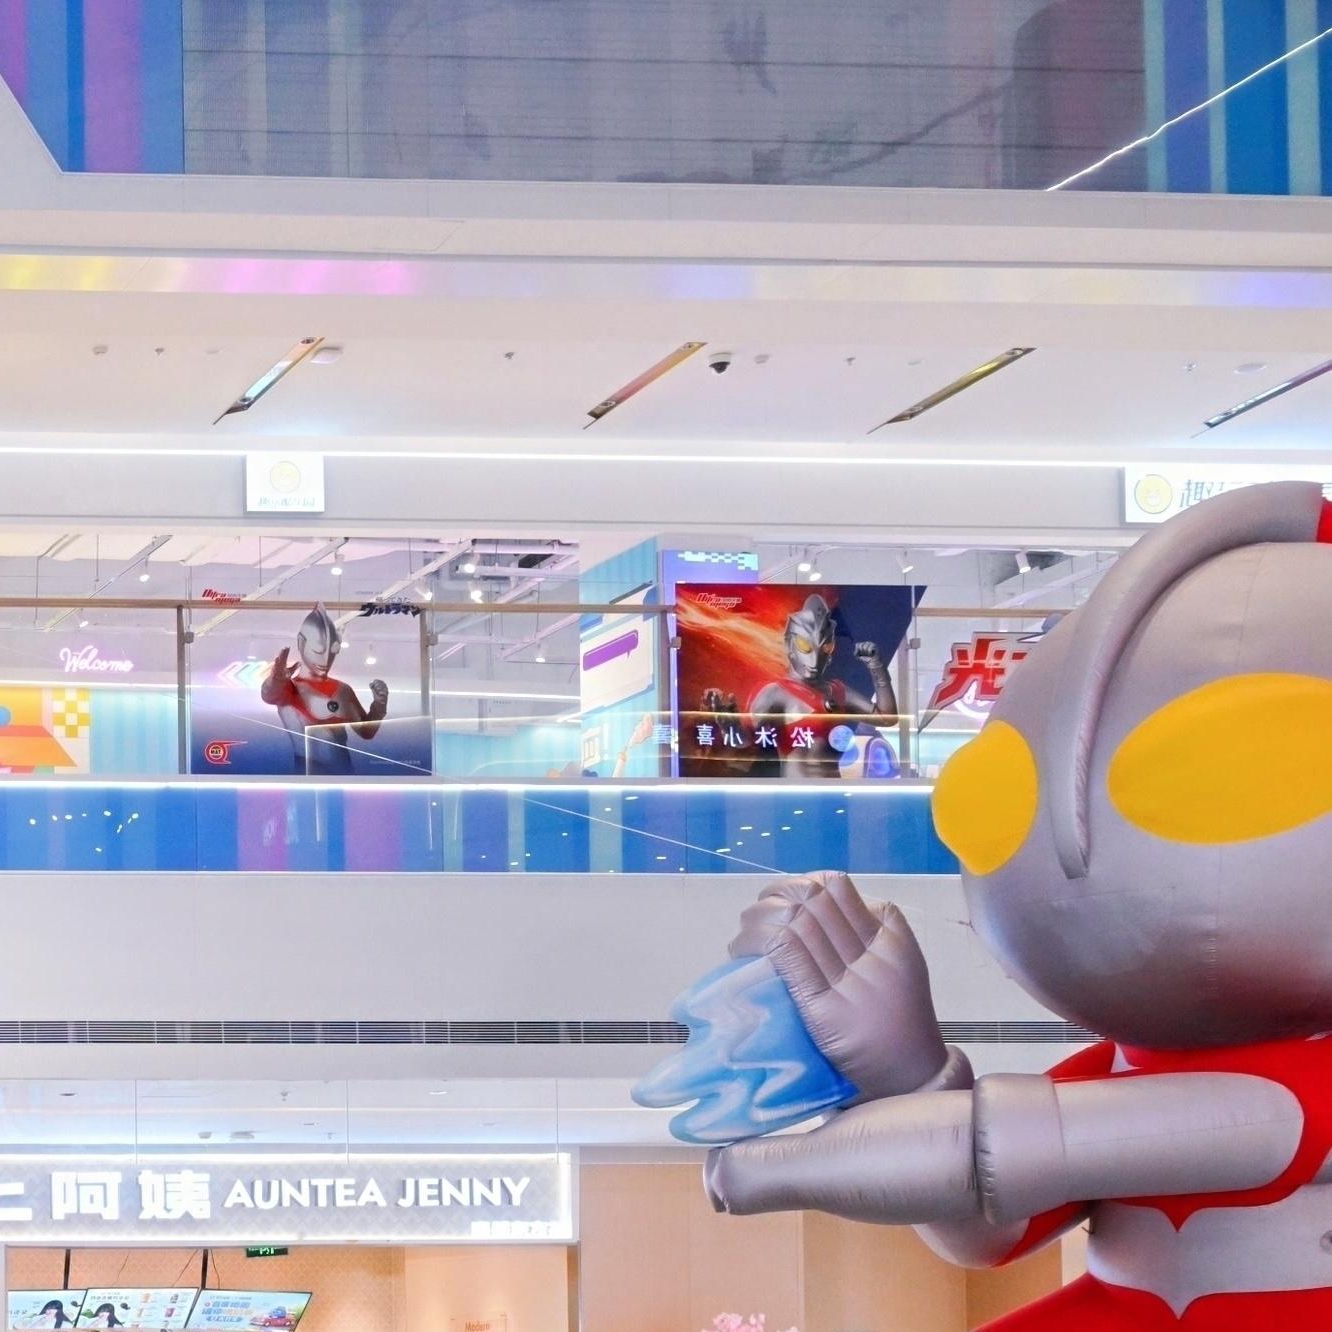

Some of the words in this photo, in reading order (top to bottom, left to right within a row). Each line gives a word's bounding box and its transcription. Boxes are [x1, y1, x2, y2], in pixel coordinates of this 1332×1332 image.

[59, 646, 134, 674] Welcome
[224, 1179, 388, 1208] AUNTEA
[397, 1176, 531, 1208] JENNY
